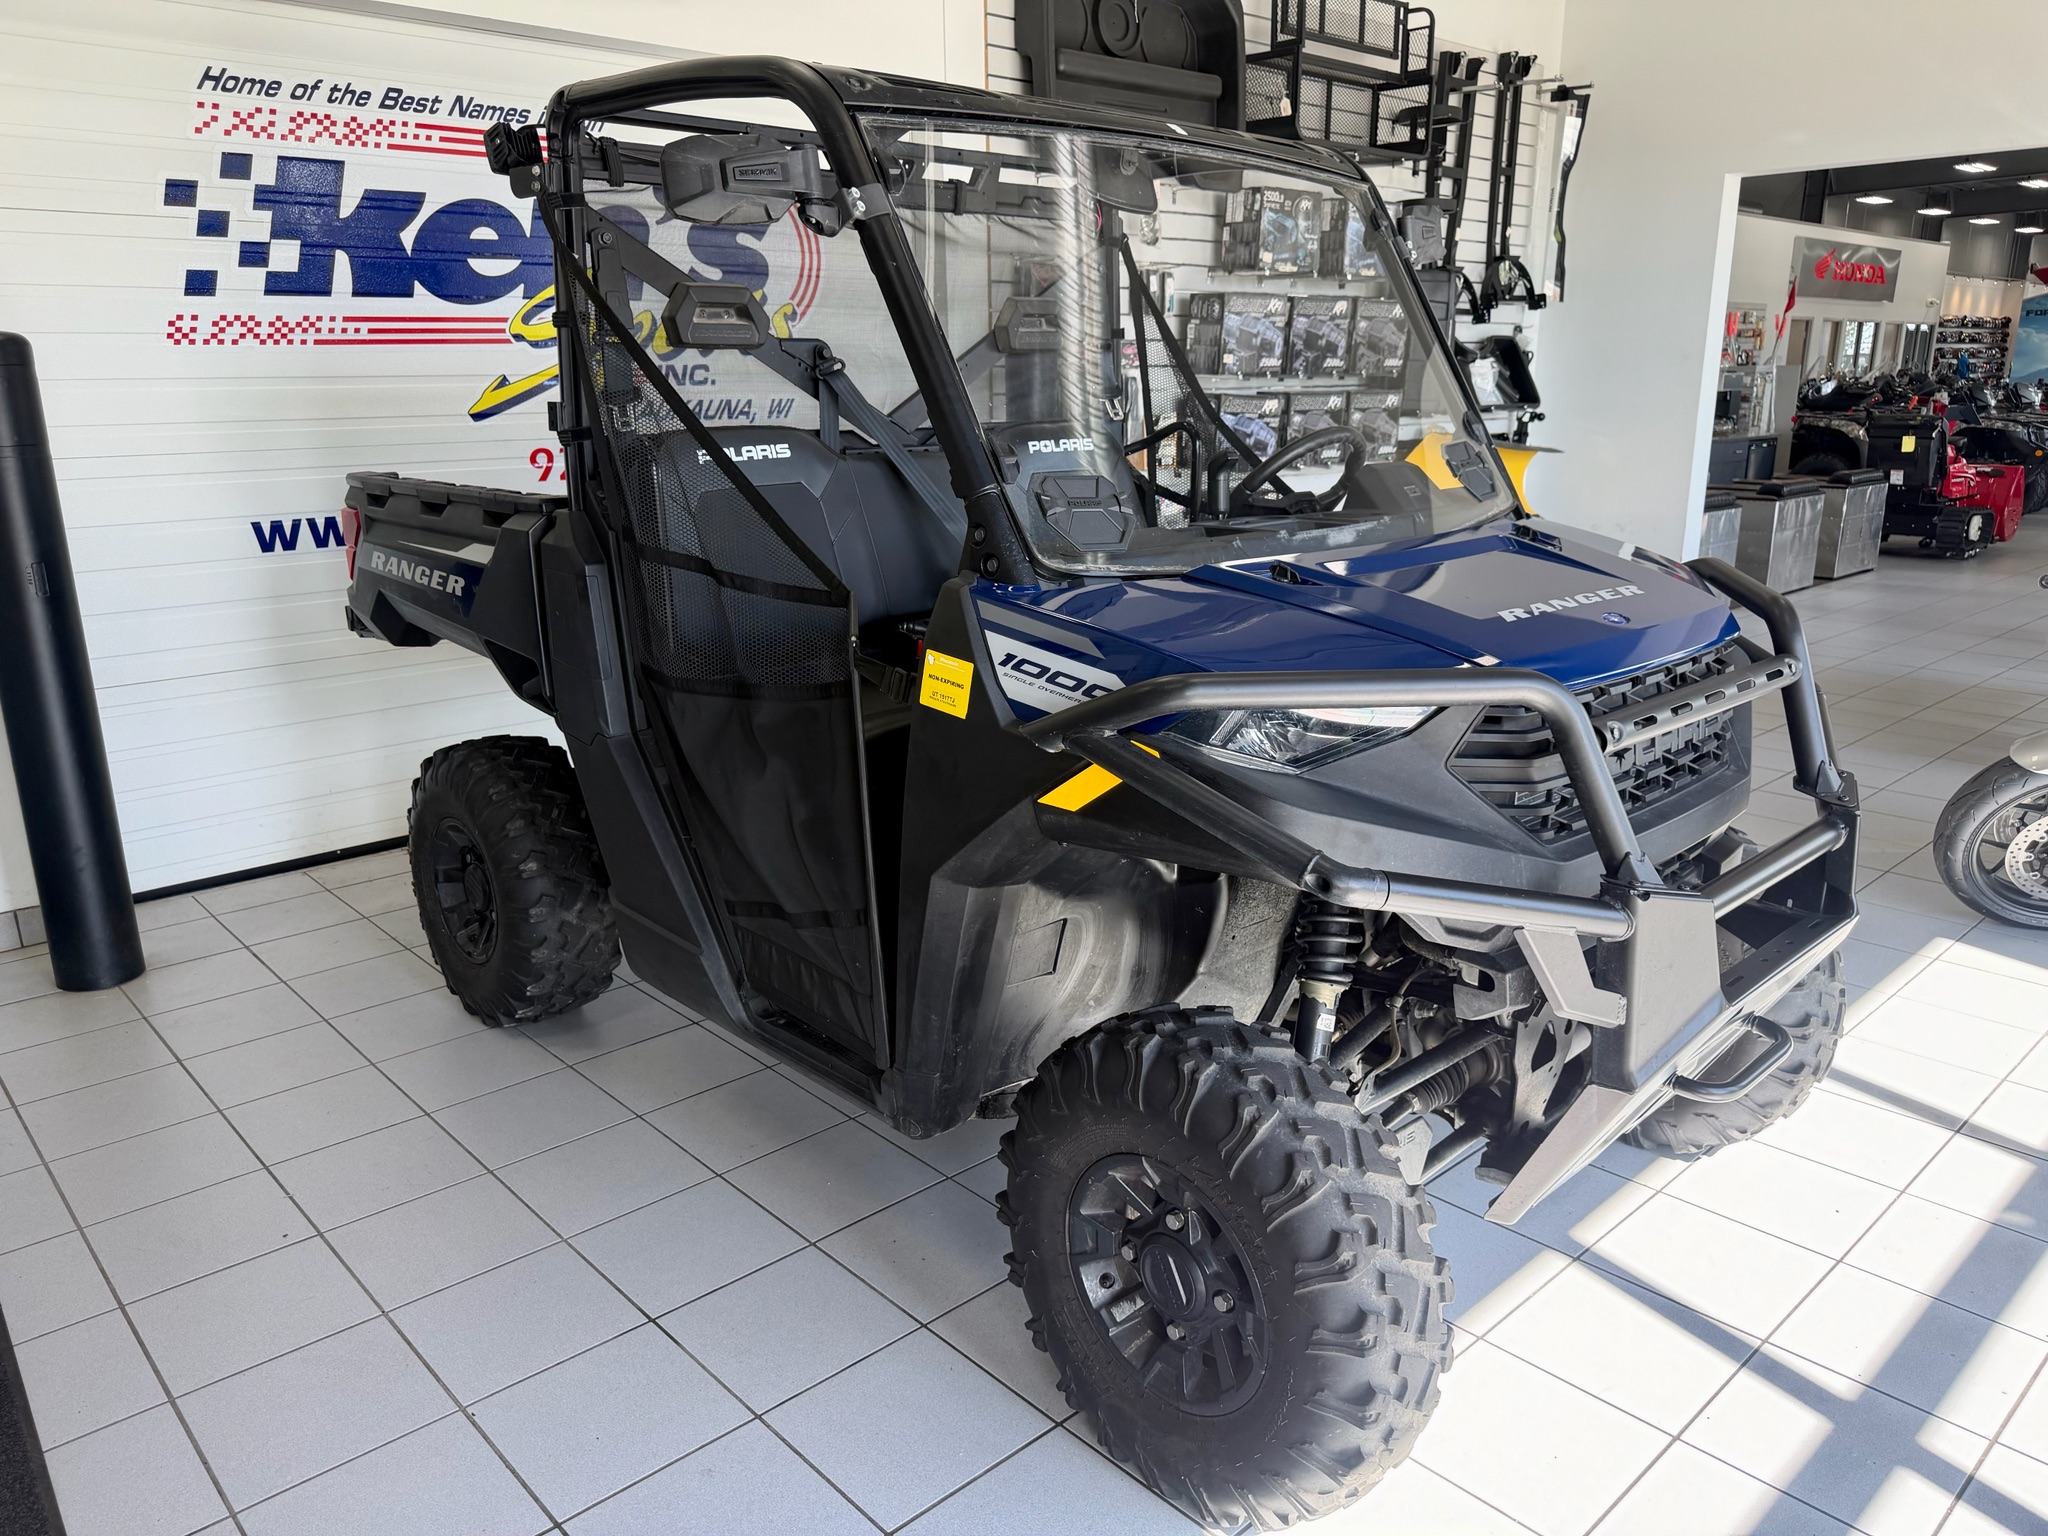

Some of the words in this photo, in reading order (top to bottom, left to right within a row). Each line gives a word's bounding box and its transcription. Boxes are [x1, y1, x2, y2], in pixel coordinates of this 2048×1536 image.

[195, 66, 283, 98] Home
[291, 82, 322, 103] of
[327, 84, 371, 109] the
[377, 88, 442, 116] Best
[447, 95, 531, 126] Names
[1832, 260, 1886, 285] HONDA
[767, 398, 795, 419] WI
[696, 443, 791, 465] PLARIS
[1028, 437, 1095, 454] POLARIS
[371, 550, 467, 597] RANGER
[1497, 584, 1645, 623] RANGER
[928, 673, 965, 690] NON-EXPIRING
[1002, 672, 1036, 687] SINGLE
[1037, 685, 1085, 704] OVERHEA
